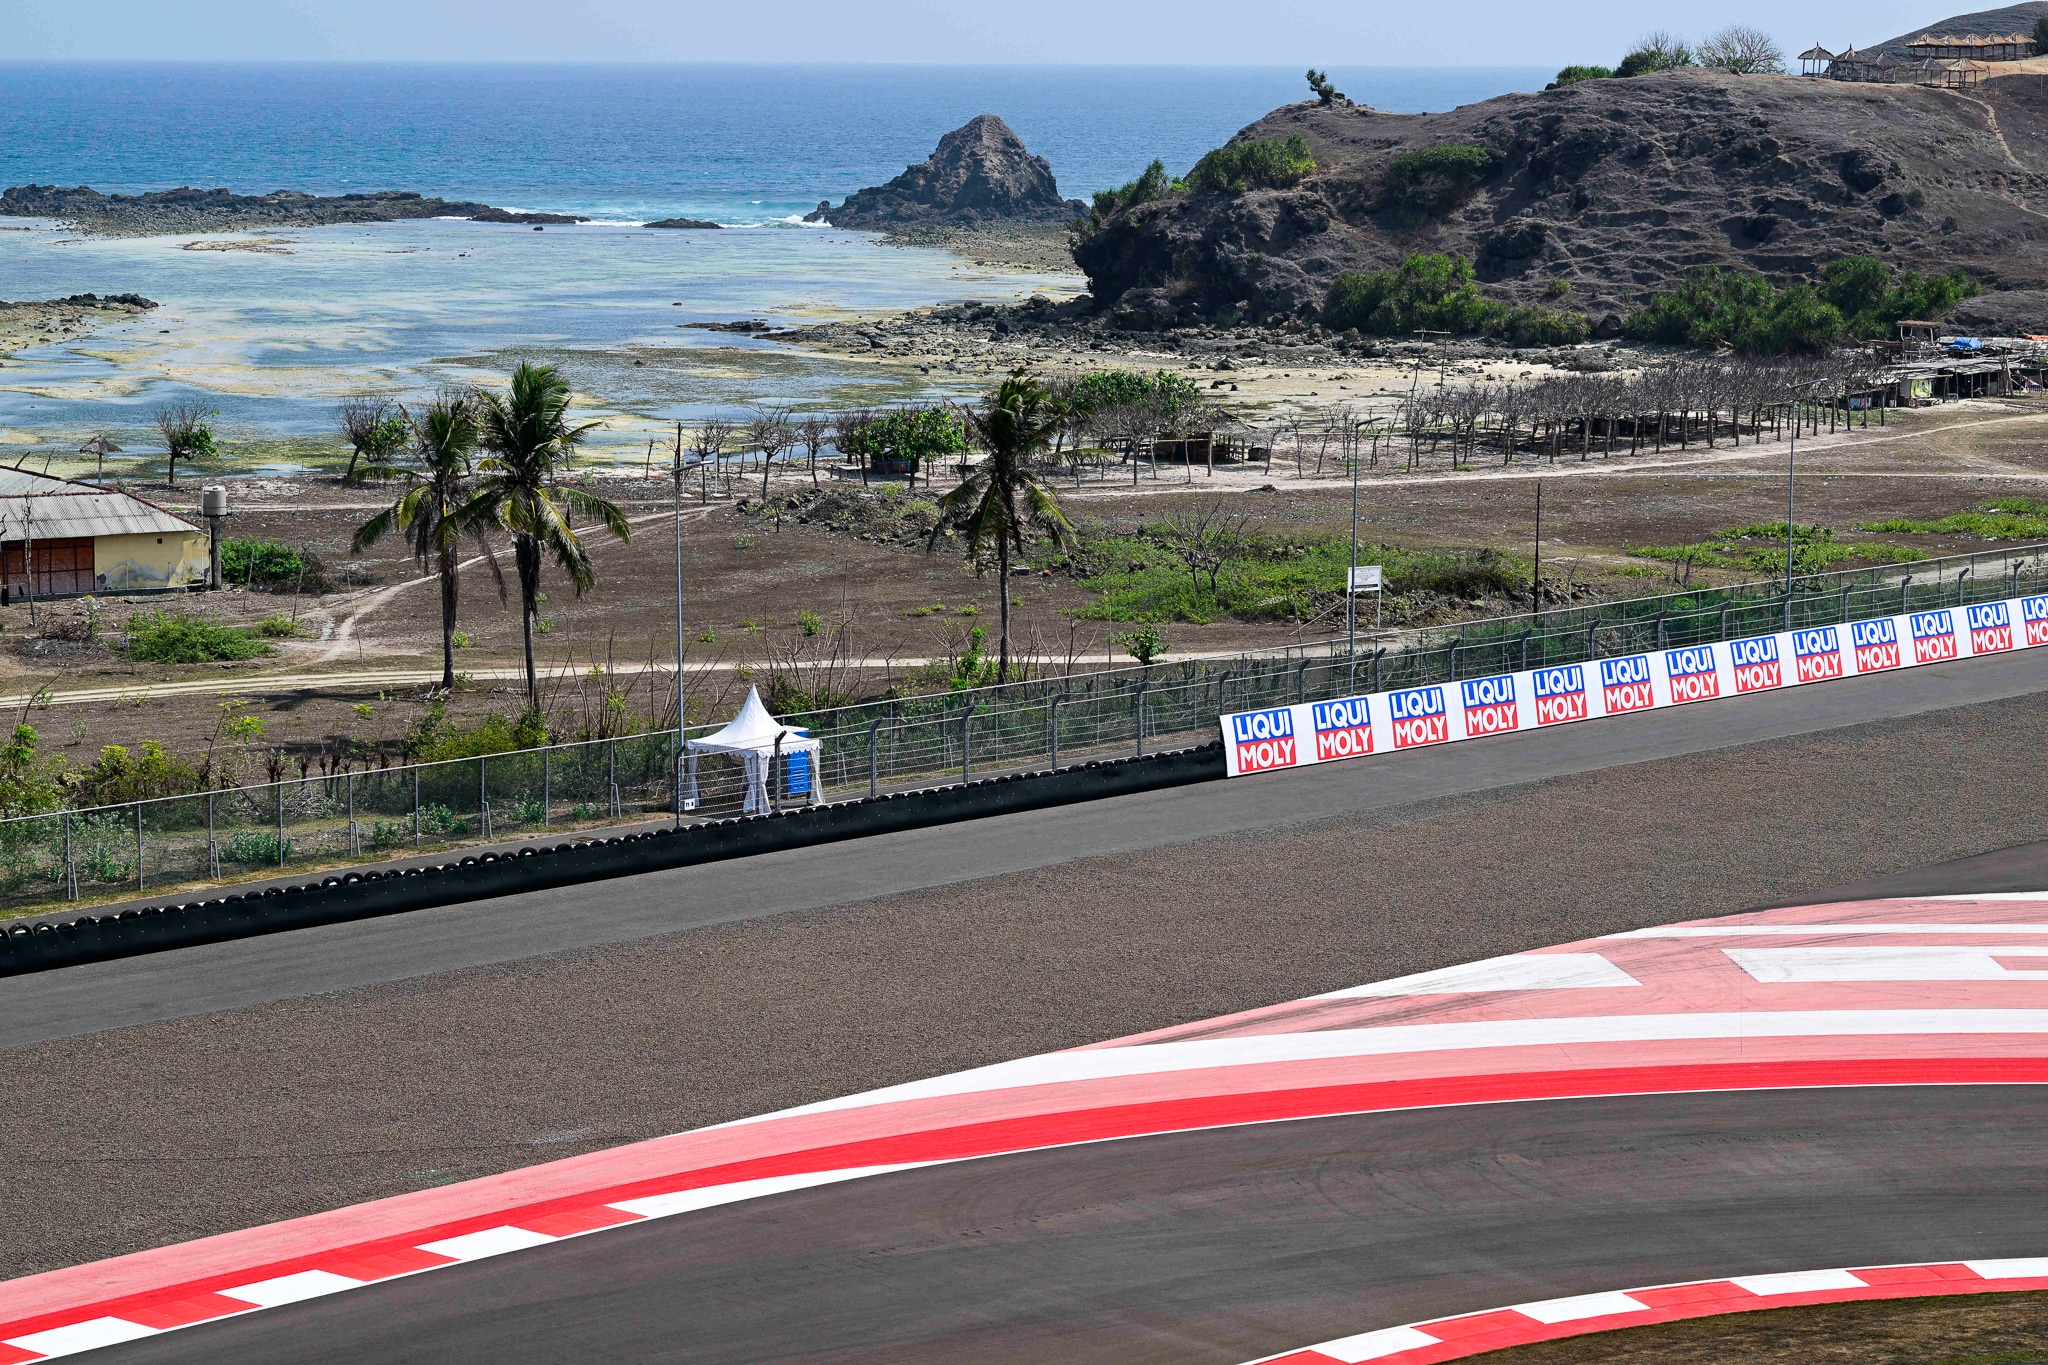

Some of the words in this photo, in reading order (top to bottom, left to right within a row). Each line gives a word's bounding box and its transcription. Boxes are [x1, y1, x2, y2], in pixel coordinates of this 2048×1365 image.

[1912, 612, 1952, 637] LIQUI
[1969, 604, 2008, 628] LIQUI
[1794, 629, 1837, 655] LIQUI
[1853, 620, 1895, 646] LIQUI
[1973, 627, 2010, 652] MOLY
[1668, 648, 1713, 675] LIQUI
[1732, 638, 1777, 665] LIQUI
[1857, 644, 1897, 670] MOLY
[1916, 635, 1954, 661] MOLY
[1602, 658, 1648, 685] LIQUI
[1736, 663, 1779, 690] MOLY
[1798, 653, 1840, 680] MOLY
[1464, 678, 1513, 706] LIQUI
[1535, 667, 1582, 695] LIQUI
[1672, 673, 1716, 701] MOLY
[1391, 689, 1443, 718] LIQUI
[1538, 693, 1584, 722] MOLY
[1606, 683, 1650, 711] MOLY
[1235, 711, 1291, 741] LIQUI
[1315, 700, 1368, 730] LIQUI
[1467, 704, 1515, 734] MOLY
[1319, 727, 1370, 758] MOLY
[1395, 716, 1445, 746] MOLY
[1240, 739, 1294, 770] MOLY
